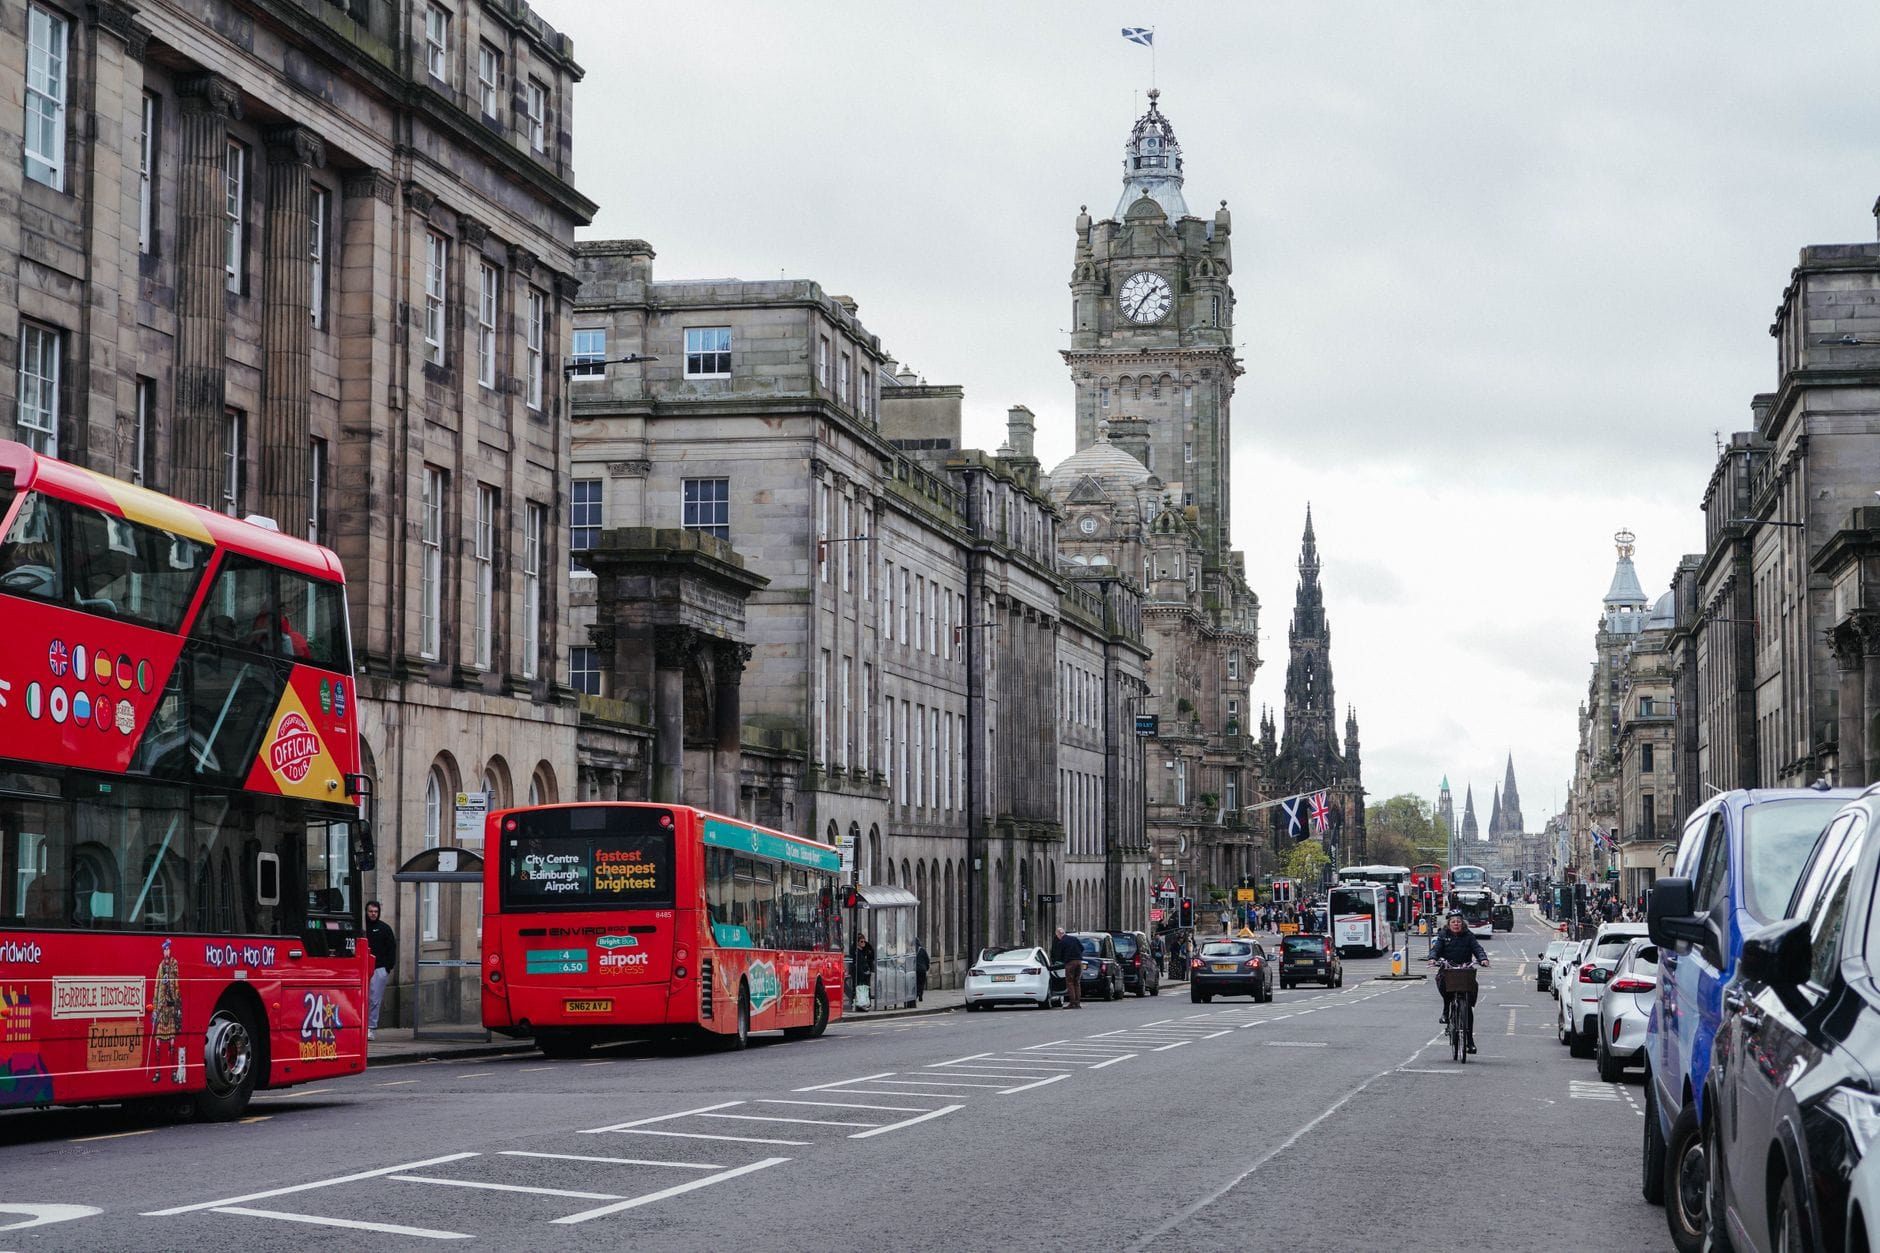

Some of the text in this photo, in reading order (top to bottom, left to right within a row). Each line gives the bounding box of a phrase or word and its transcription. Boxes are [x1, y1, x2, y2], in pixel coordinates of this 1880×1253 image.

[275, 737, 318, 766] OFFICIAL
[289, 760, 308, 779] TOUR
[525, 854, 579, 867] City Centre
[595, 849, 642, 862] fastest
[520, 869, 579, 882] & Edinburgh
[595, 862, 656, 878] cheapest
[544, 881, 579, 893] Airport
[595, 876, 656, 893] brightest
[599, 935, 634, 946] Bright Bus
[206, 944, 224, 968] Hop
[225, 944, 237, 965] On
[244, 946, 261, 967] Hop
[262, 945, 275, 965] Off
[599, 950, 648, 967] airport
[599, 965, 645, 977] express
[569, 1002, 608, 1011] SN62 AYJ
[301, 993, 324, 1038] 24
[90, 1027, 141, 1053] Edinburgh
[97, 1050, 112, 1065] Terry
[113, 1049, 129, 1064] Deary
